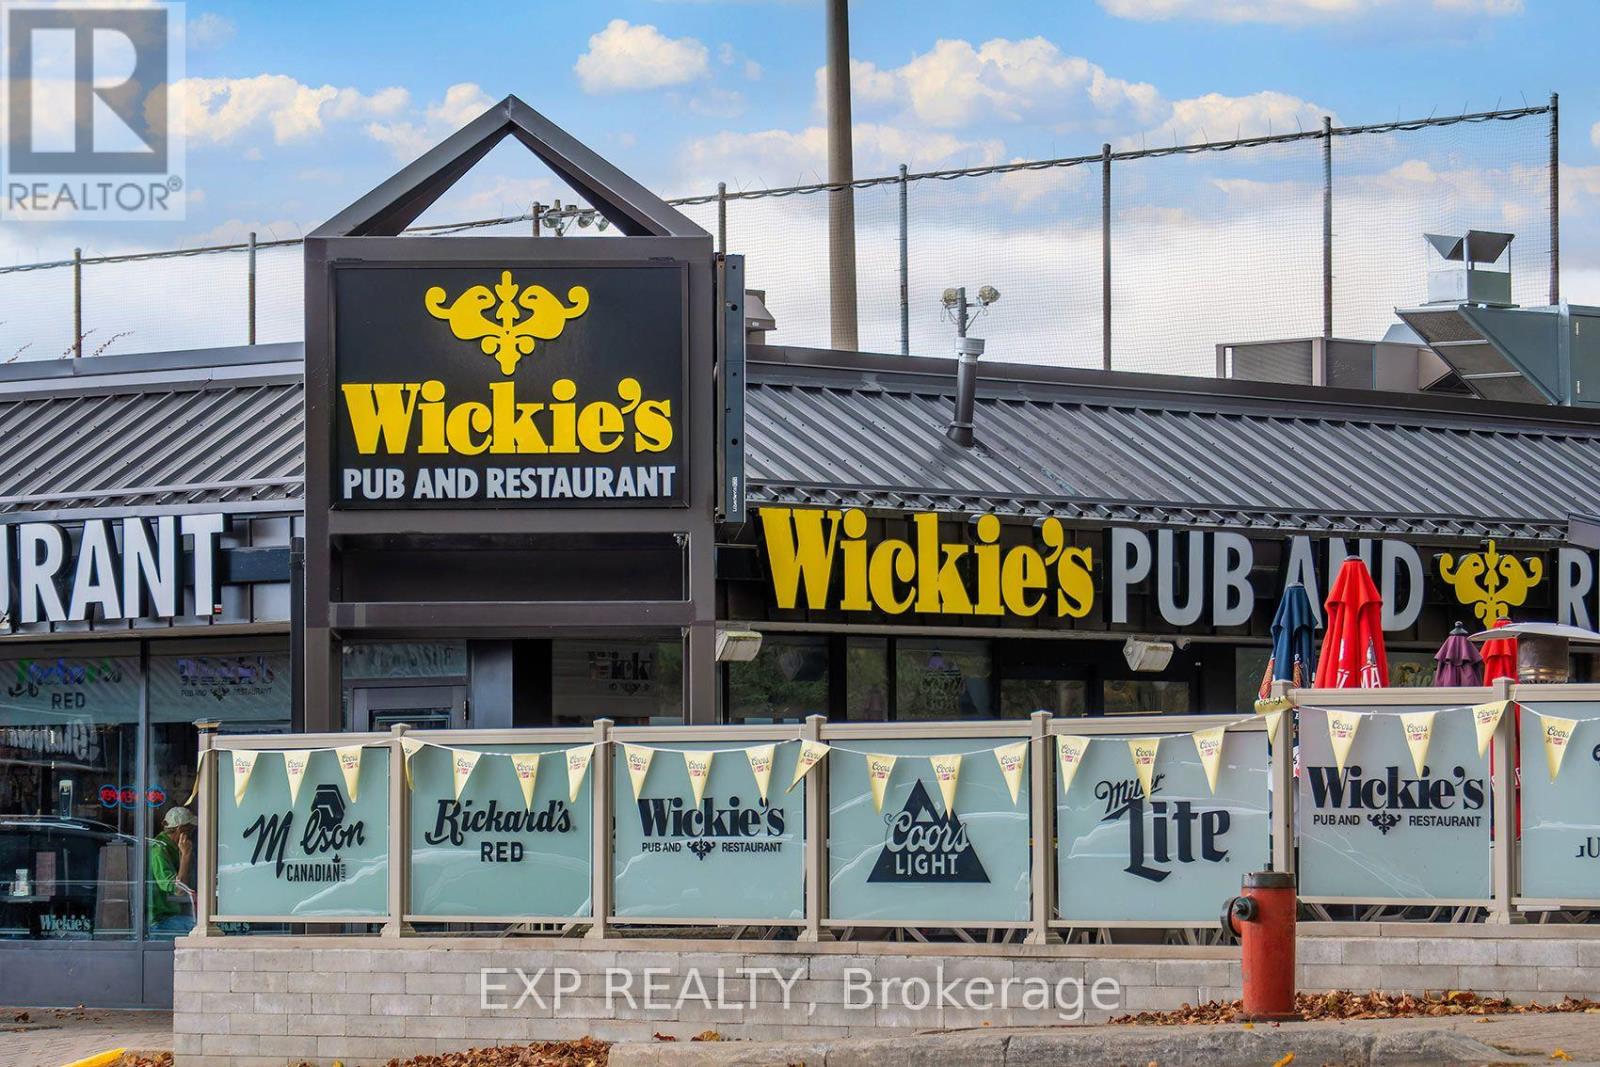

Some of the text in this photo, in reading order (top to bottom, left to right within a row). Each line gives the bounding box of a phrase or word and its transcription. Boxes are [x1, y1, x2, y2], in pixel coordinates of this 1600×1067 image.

[341, 378, 673, 456] Wickie's
[343, 466, 676, 499] PUB AND RESTAURANT
[0, 513, 224, 624] RANT
[759, 507, 1095, 619] Wickie's
[1112, 527, 1255, 627] PUB
[1558, 548, 1600, 632] R
[51, 692, 86, 710] RED
[1307, 765, 1484, 810] Wickie's
[424, 799, 572, 847] Rickard's
[637, 796, 785, 837] Wickie's
[884, 811, 970, 853] Coors
[1313, 814, 1482, 827] PUB AND RESTAURANT
[243, 810, 365, 879] Mlson
[480, 841, 524, 862] RED
[641, 842, 783, 853] PUB AND RESTAURANT
[1123, 798, 1232, 882] Lite
[286, 863, 340, 882] CANADIAN
[895, 853, 959, 875] LIGHT
